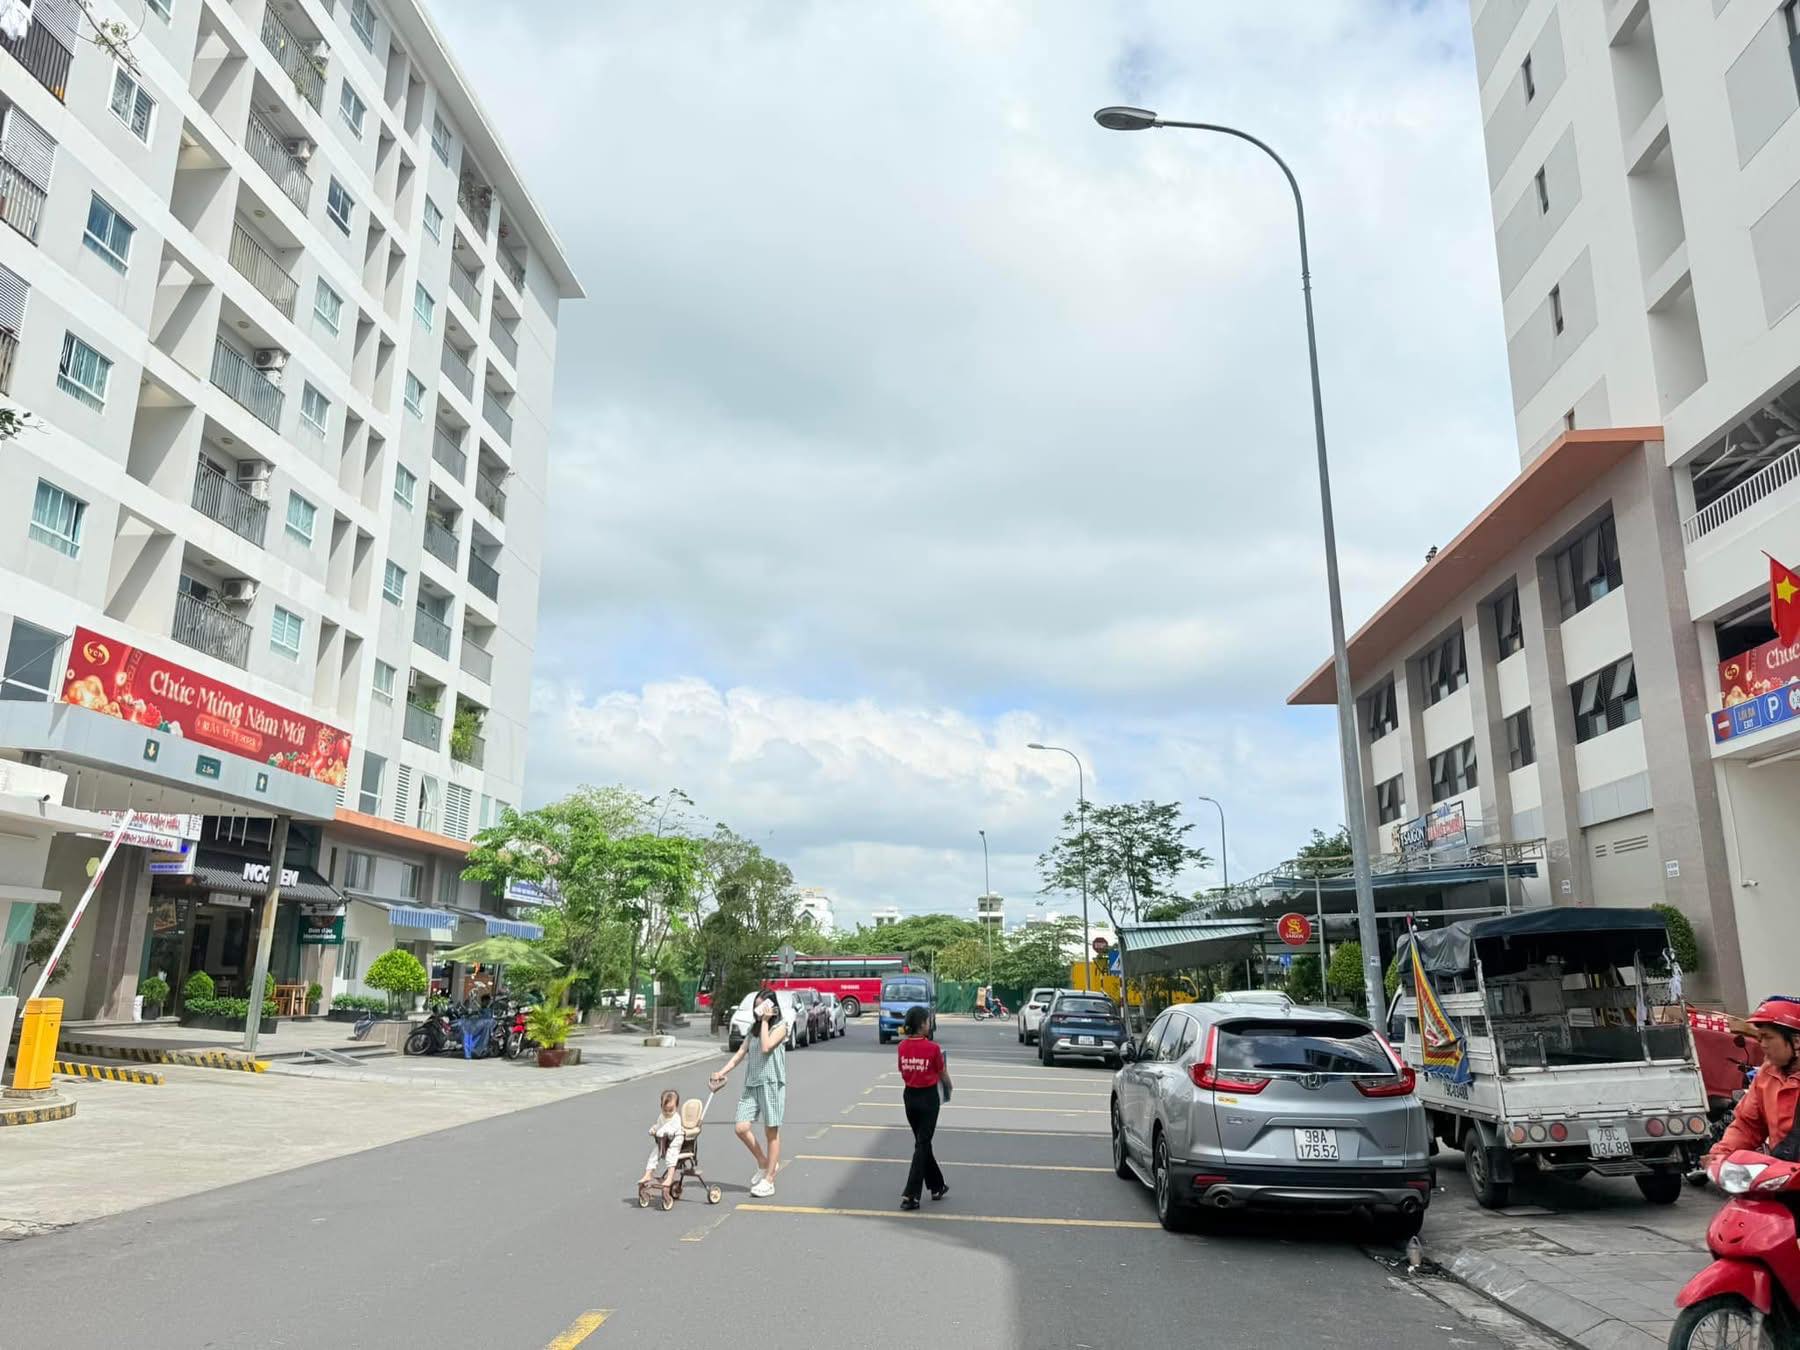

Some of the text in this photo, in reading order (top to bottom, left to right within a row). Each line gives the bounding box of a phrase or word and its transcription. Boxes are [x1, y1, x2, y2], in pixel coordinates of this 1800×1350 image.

[150, 670, 306, 746] Chúc Mừng Năm Mới
[1767, 696, 1779, 719] P
[1305, 1130, 1328, 1143] 98A
[1598, 1129, 1620, 1142] 79C
[1299, 1145, 1338, 1159] 175.52
